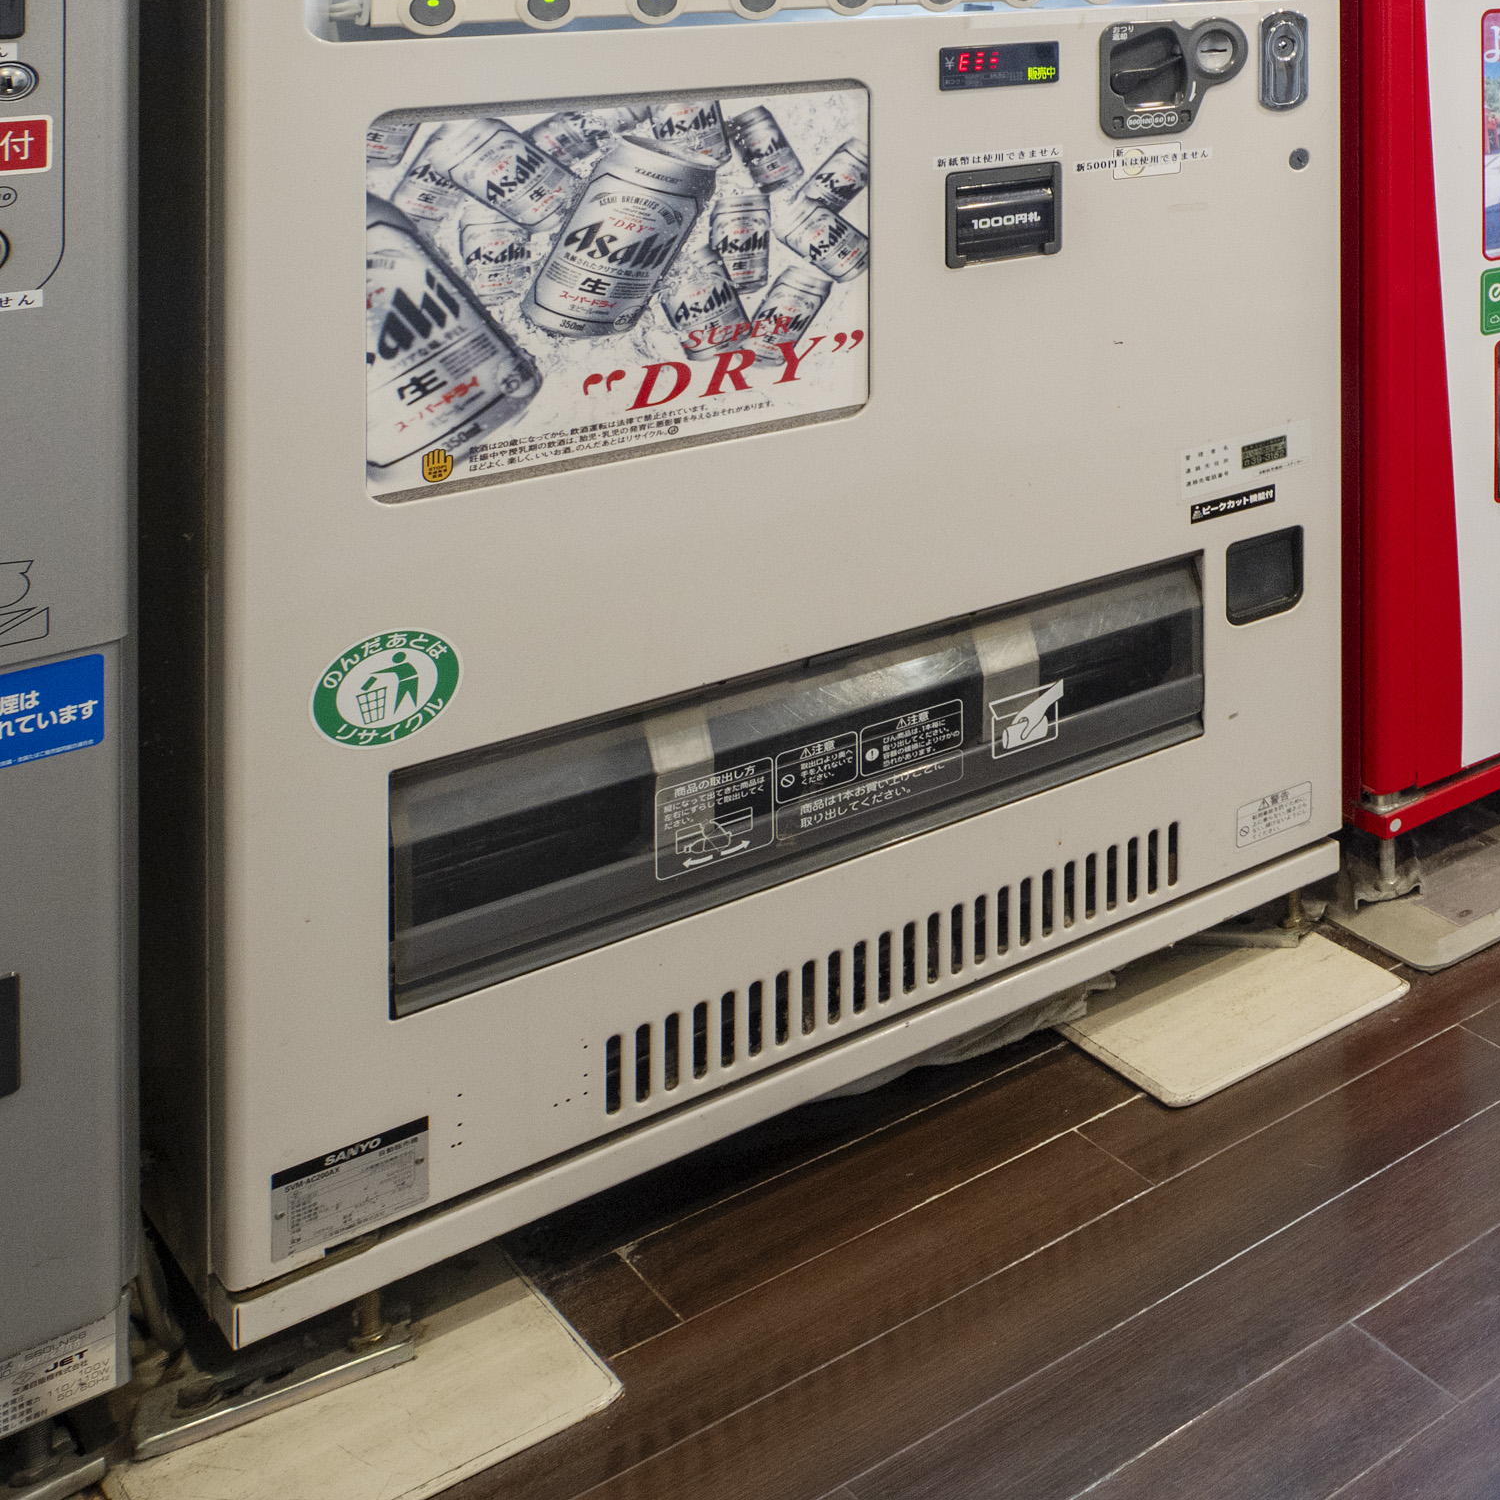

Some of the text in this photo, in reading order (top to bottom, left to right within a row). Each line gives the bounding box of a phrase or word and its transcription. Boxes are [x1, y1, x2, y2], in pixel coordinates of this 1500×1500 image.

[1112, 25, 1134, 33] おつり
[1028, 66, 1056, 80] 販売中
[1, 135, 34, 161] 付
[937, 147, 1060, 167] 新紙幣は使用できません
[1076, 150, 1209, 172] 新500円玉は使用できません
[599, 196, 617, 206] ASAHI
[621, 195, 660, 211] BREWERIES
[971, 212, 1041, 230] 1000円札
[564, 221, 678, 270] Asahi
[579, 277, 611, 296] 生
[559, 290, 617, 309] スーパードライ
[568, 304, 593, 315] 生ビール
[560, 319, 585, 331] 350ml
[684, 316, 793, 350] SUPER
[583, 329, 865, 411] “DRY”
[1202, 488, 1274, 516] ピークカット機能付
[322, 632, 447, 689] のんだあとは
[335, 697, 443, 745] リサイクル
[907, 709, 930, 725] 注意
[811, 739, 835, 756] 注意
[882, 726, 950, 752] 取り出してください。
[800, 748, 853, 771] 取出口より奥へ
[800, 757, 853, 778] 手を入れないで
[882, 746, 936, 767] 恐れがあります。
[674, 765, 755, 797] 商品の取出し方
[801, 770, 837, 786] ください。
[663, 775, 765, 813] 縦になって出てきた商品は
[663, 784, 765, 822] 左右にずらして取出してく
[800, 787, 911, 829] 取り出してください。
[663, 817, 694, 831] ださい。
[324, 1137, 382, 1166] SANYO
[45, 1349, 88, 1373] JET
